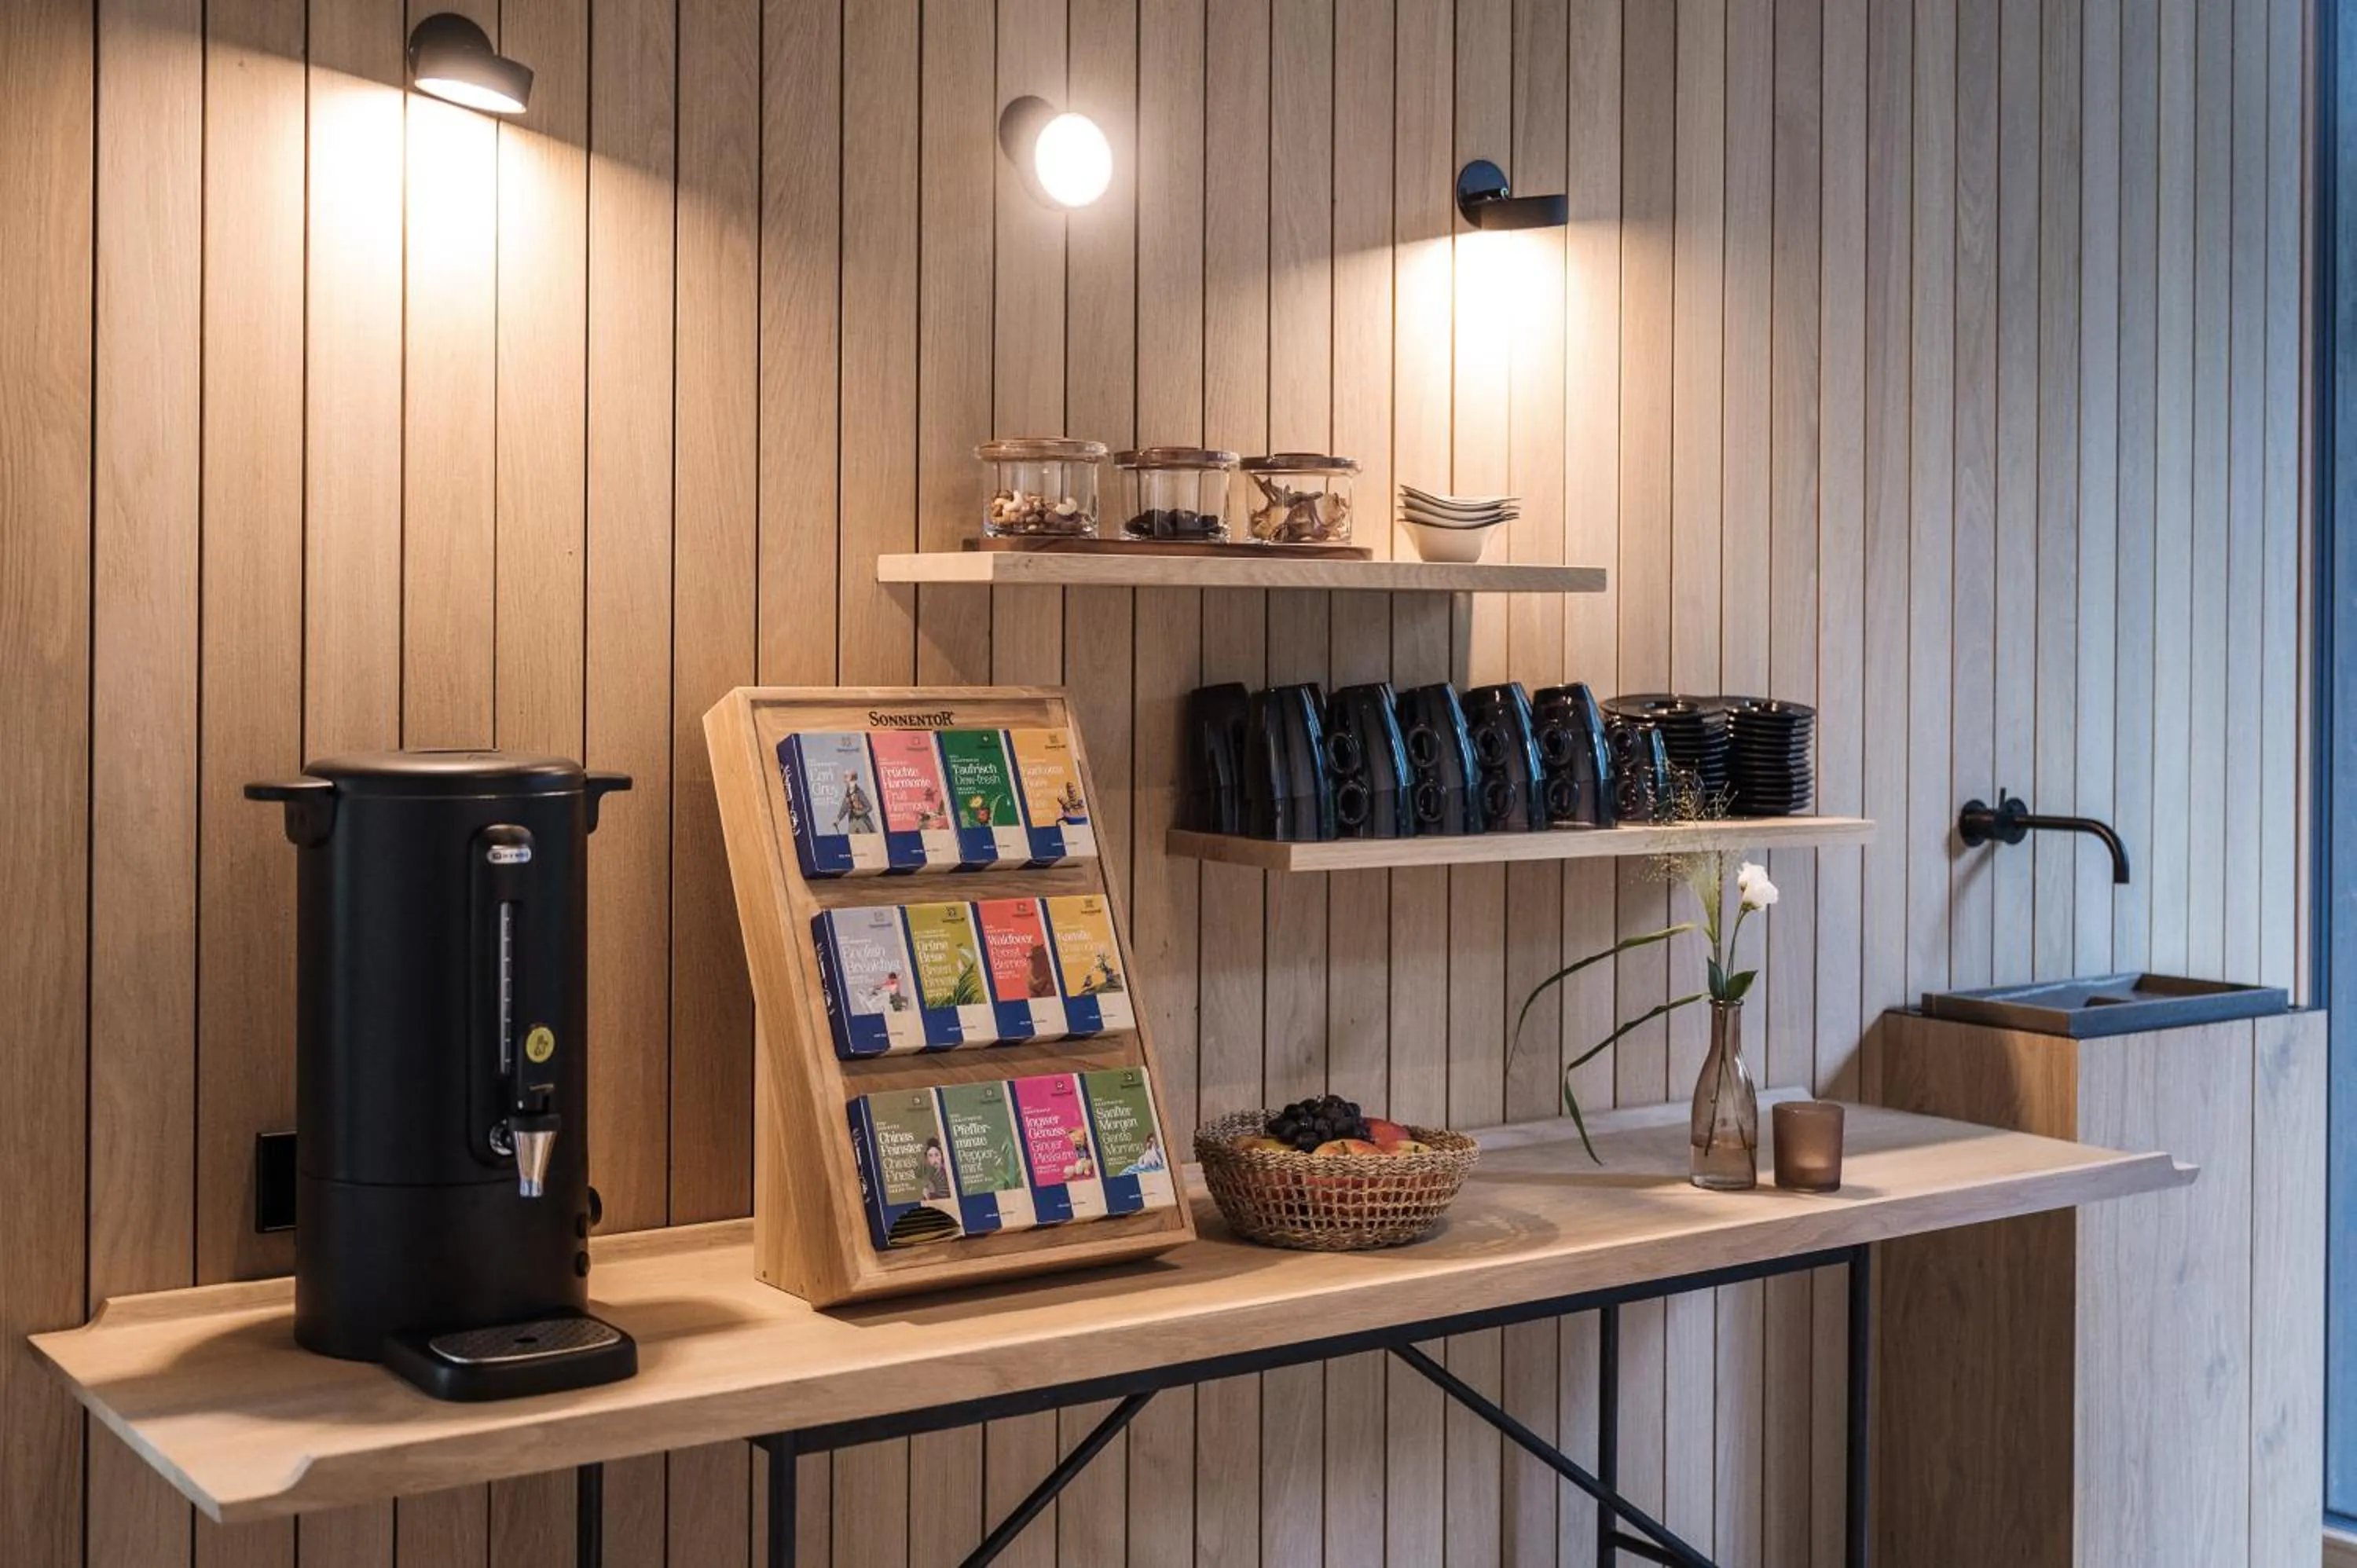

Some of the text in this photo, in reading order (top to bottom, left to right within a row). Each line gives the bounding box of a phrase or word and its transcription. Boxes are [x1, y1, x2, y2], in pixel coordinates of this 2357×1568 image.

[868, 711, 955, 727] SONNENTOR
[952, 763, 997, 775] Taufrisch
[1099, 1118, 1138, 1131] Morgen
